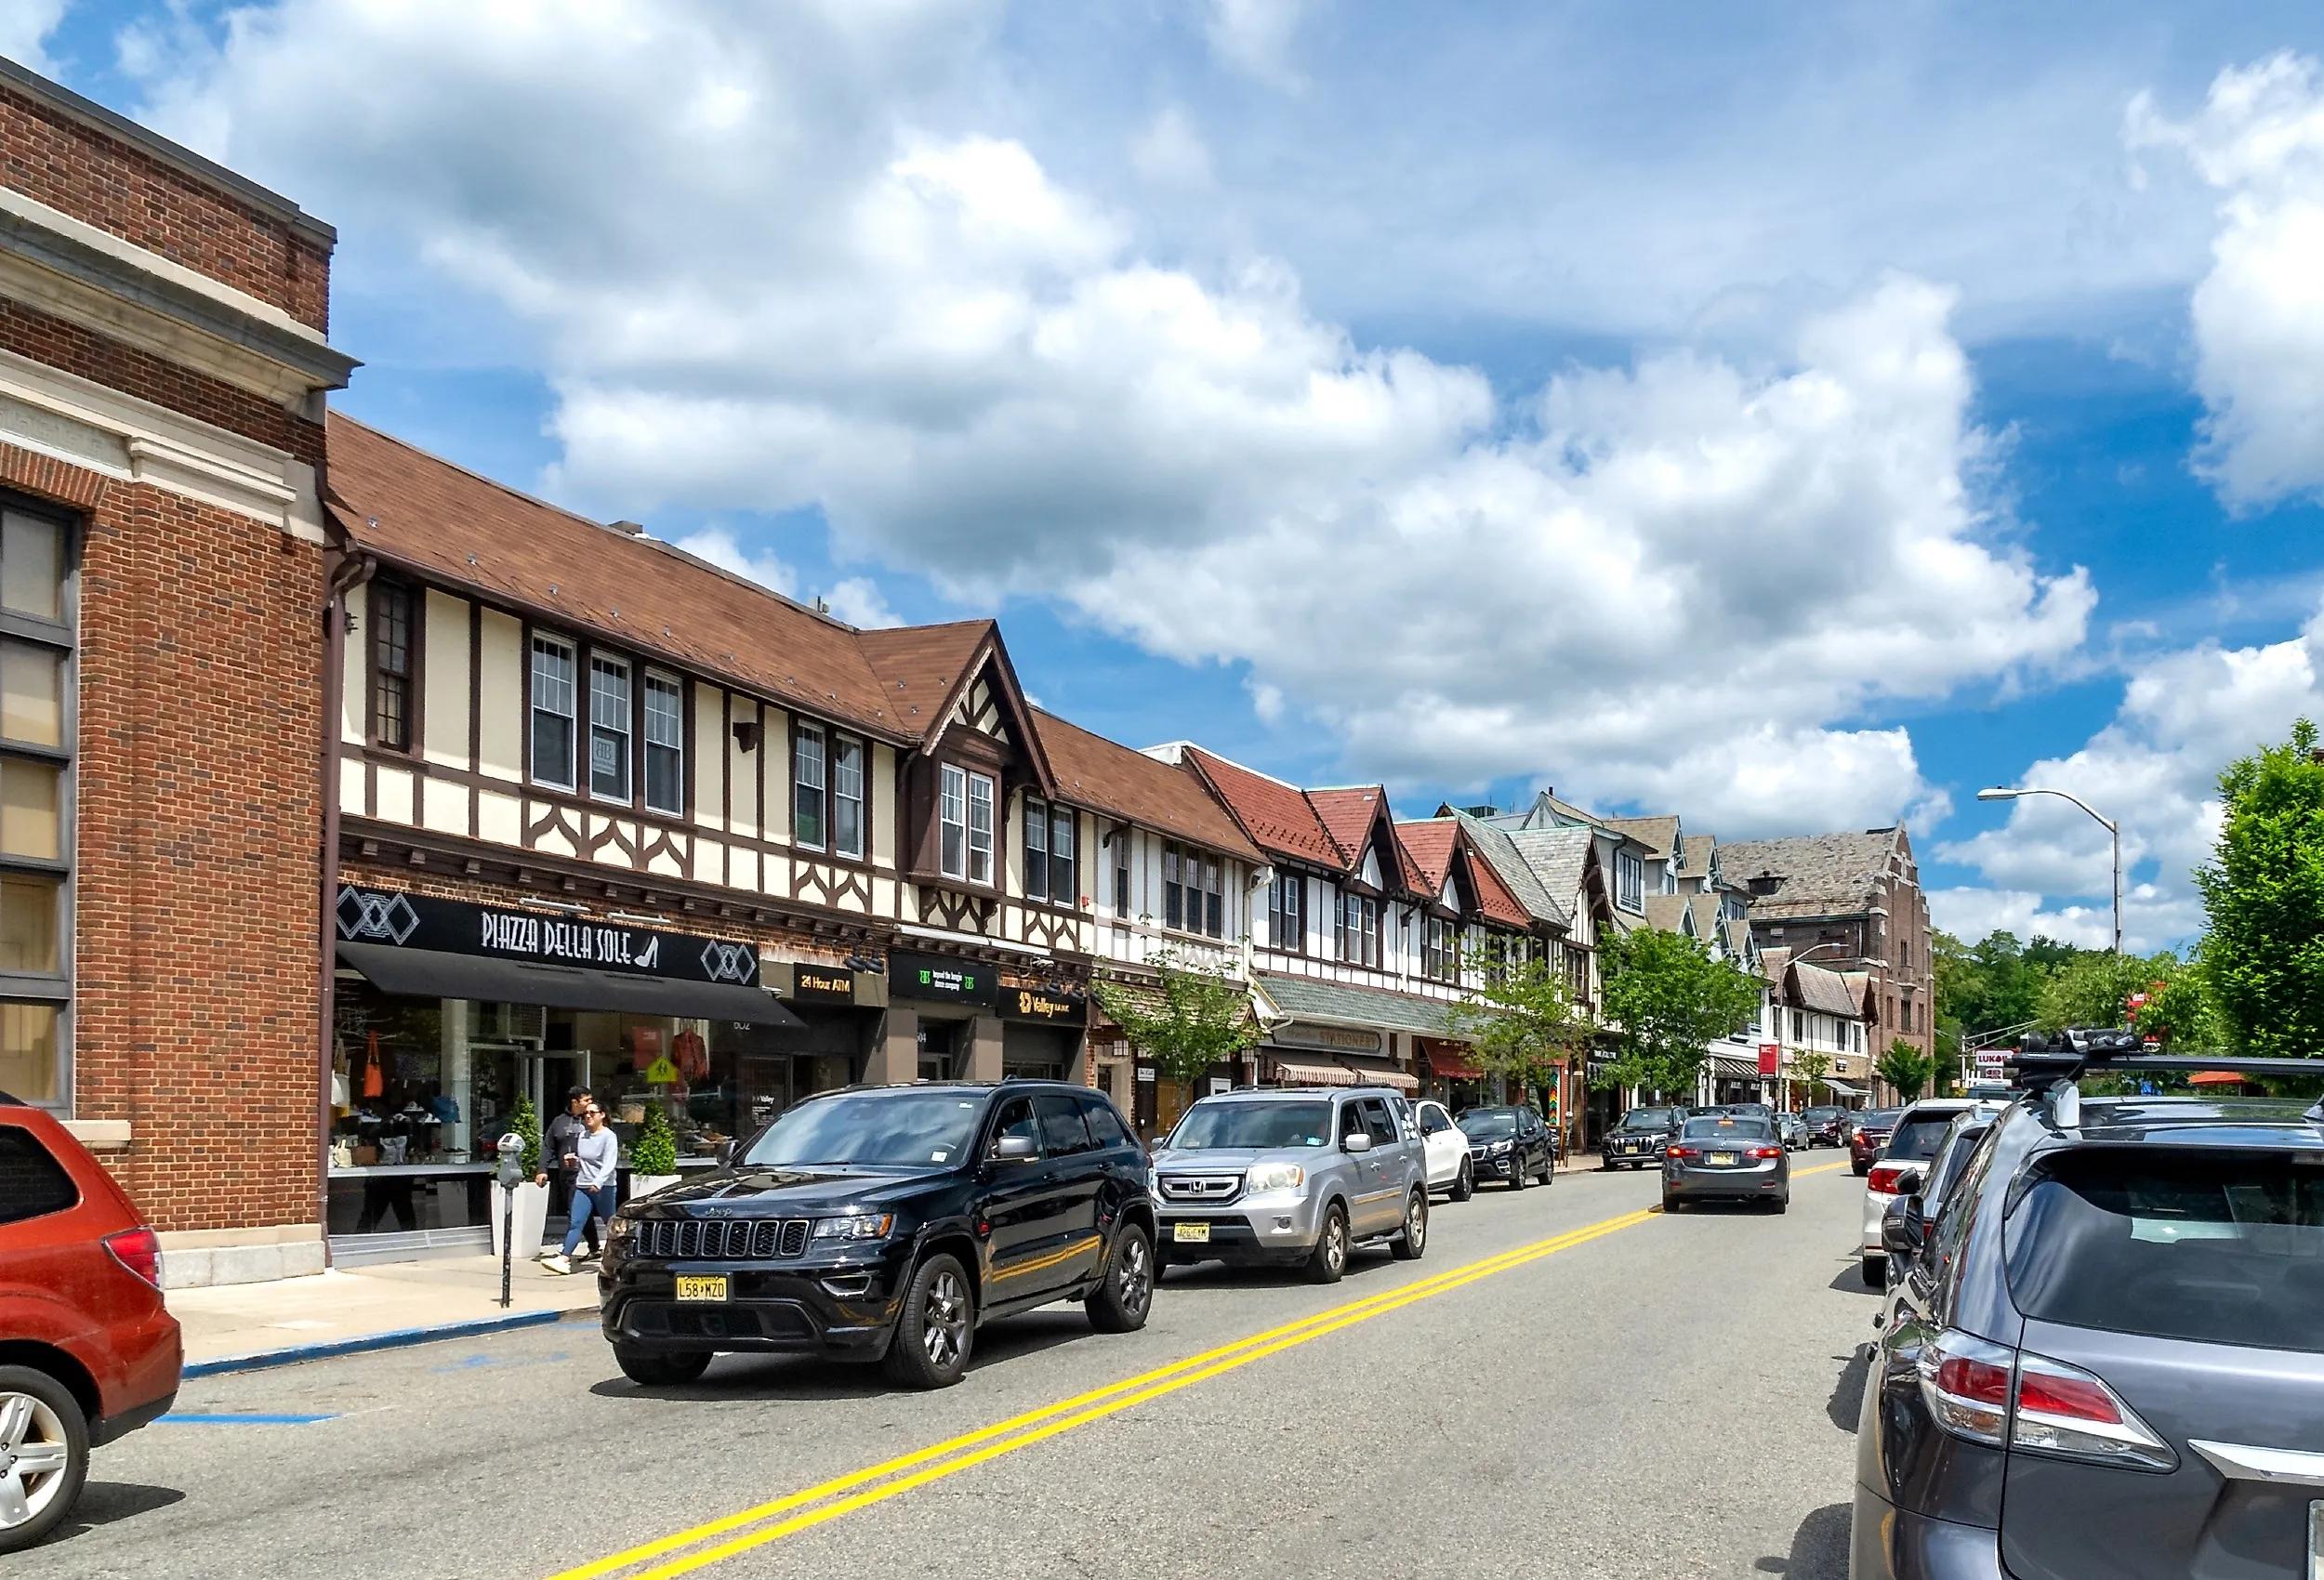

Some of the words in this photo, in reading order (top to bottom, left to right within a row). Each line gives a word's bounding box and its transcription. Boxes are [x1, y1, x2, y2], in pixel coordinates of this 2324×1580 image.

[482, 911, 538, 954] PIAZZA
[544, 920, 592, 960] DELLA
[597, 928, 632, 965] SOLE
[800, 975, 812, 988] 24
[812, 976, 831, 991] Hour
[832, 979, 851, 993] ATM
[1032, 996, 1054, 1019] Valley
[706, 1206, 733, 1218] Jeep
